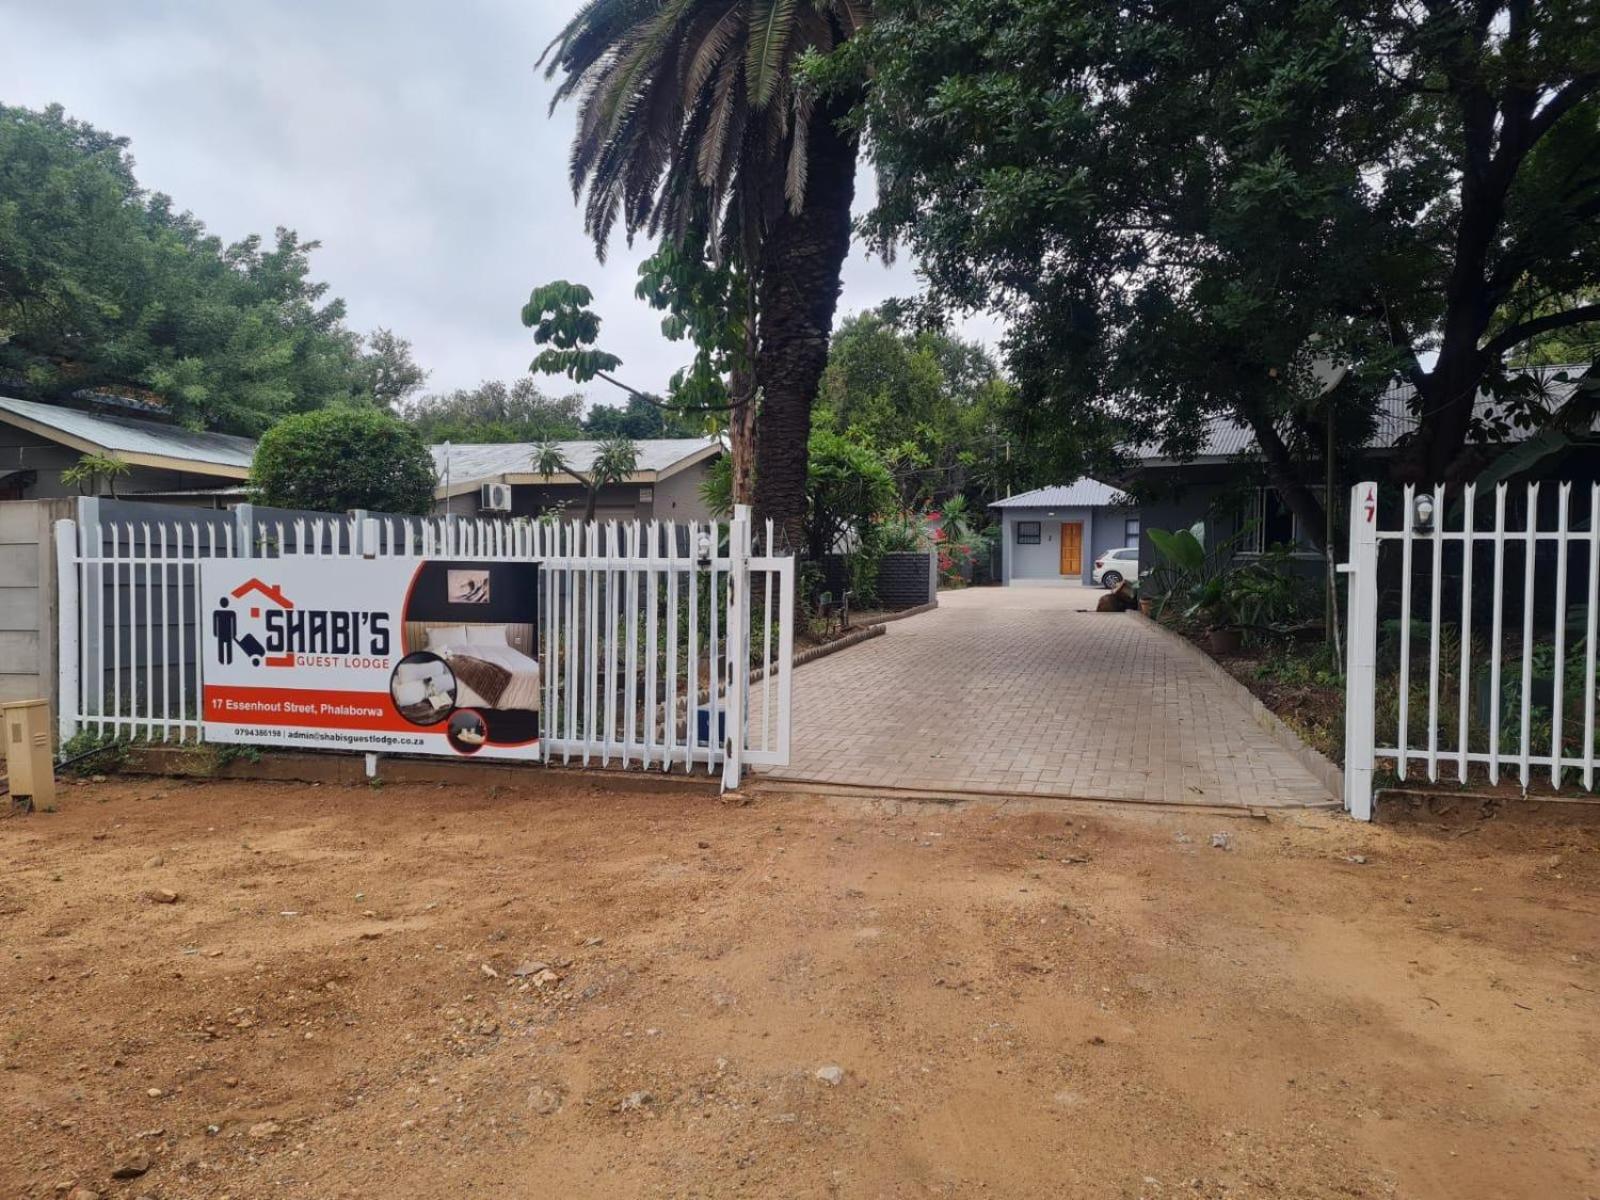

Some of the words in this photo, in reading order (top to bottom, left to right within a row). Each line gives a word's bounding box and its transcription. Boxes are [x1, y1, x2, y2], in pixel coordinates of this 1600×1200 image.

[266, 610, 390, 655] SHABI'S
[297, 656, 340, 667] GUEST
[344, 658, 390, 669] LODGE
[212, 698, 223, 709] 17
[226, 700, 281, 712] Essenhout
[284, 701, 318, 715] Street,
[321, 703, 383, 717] Phalaborwa
